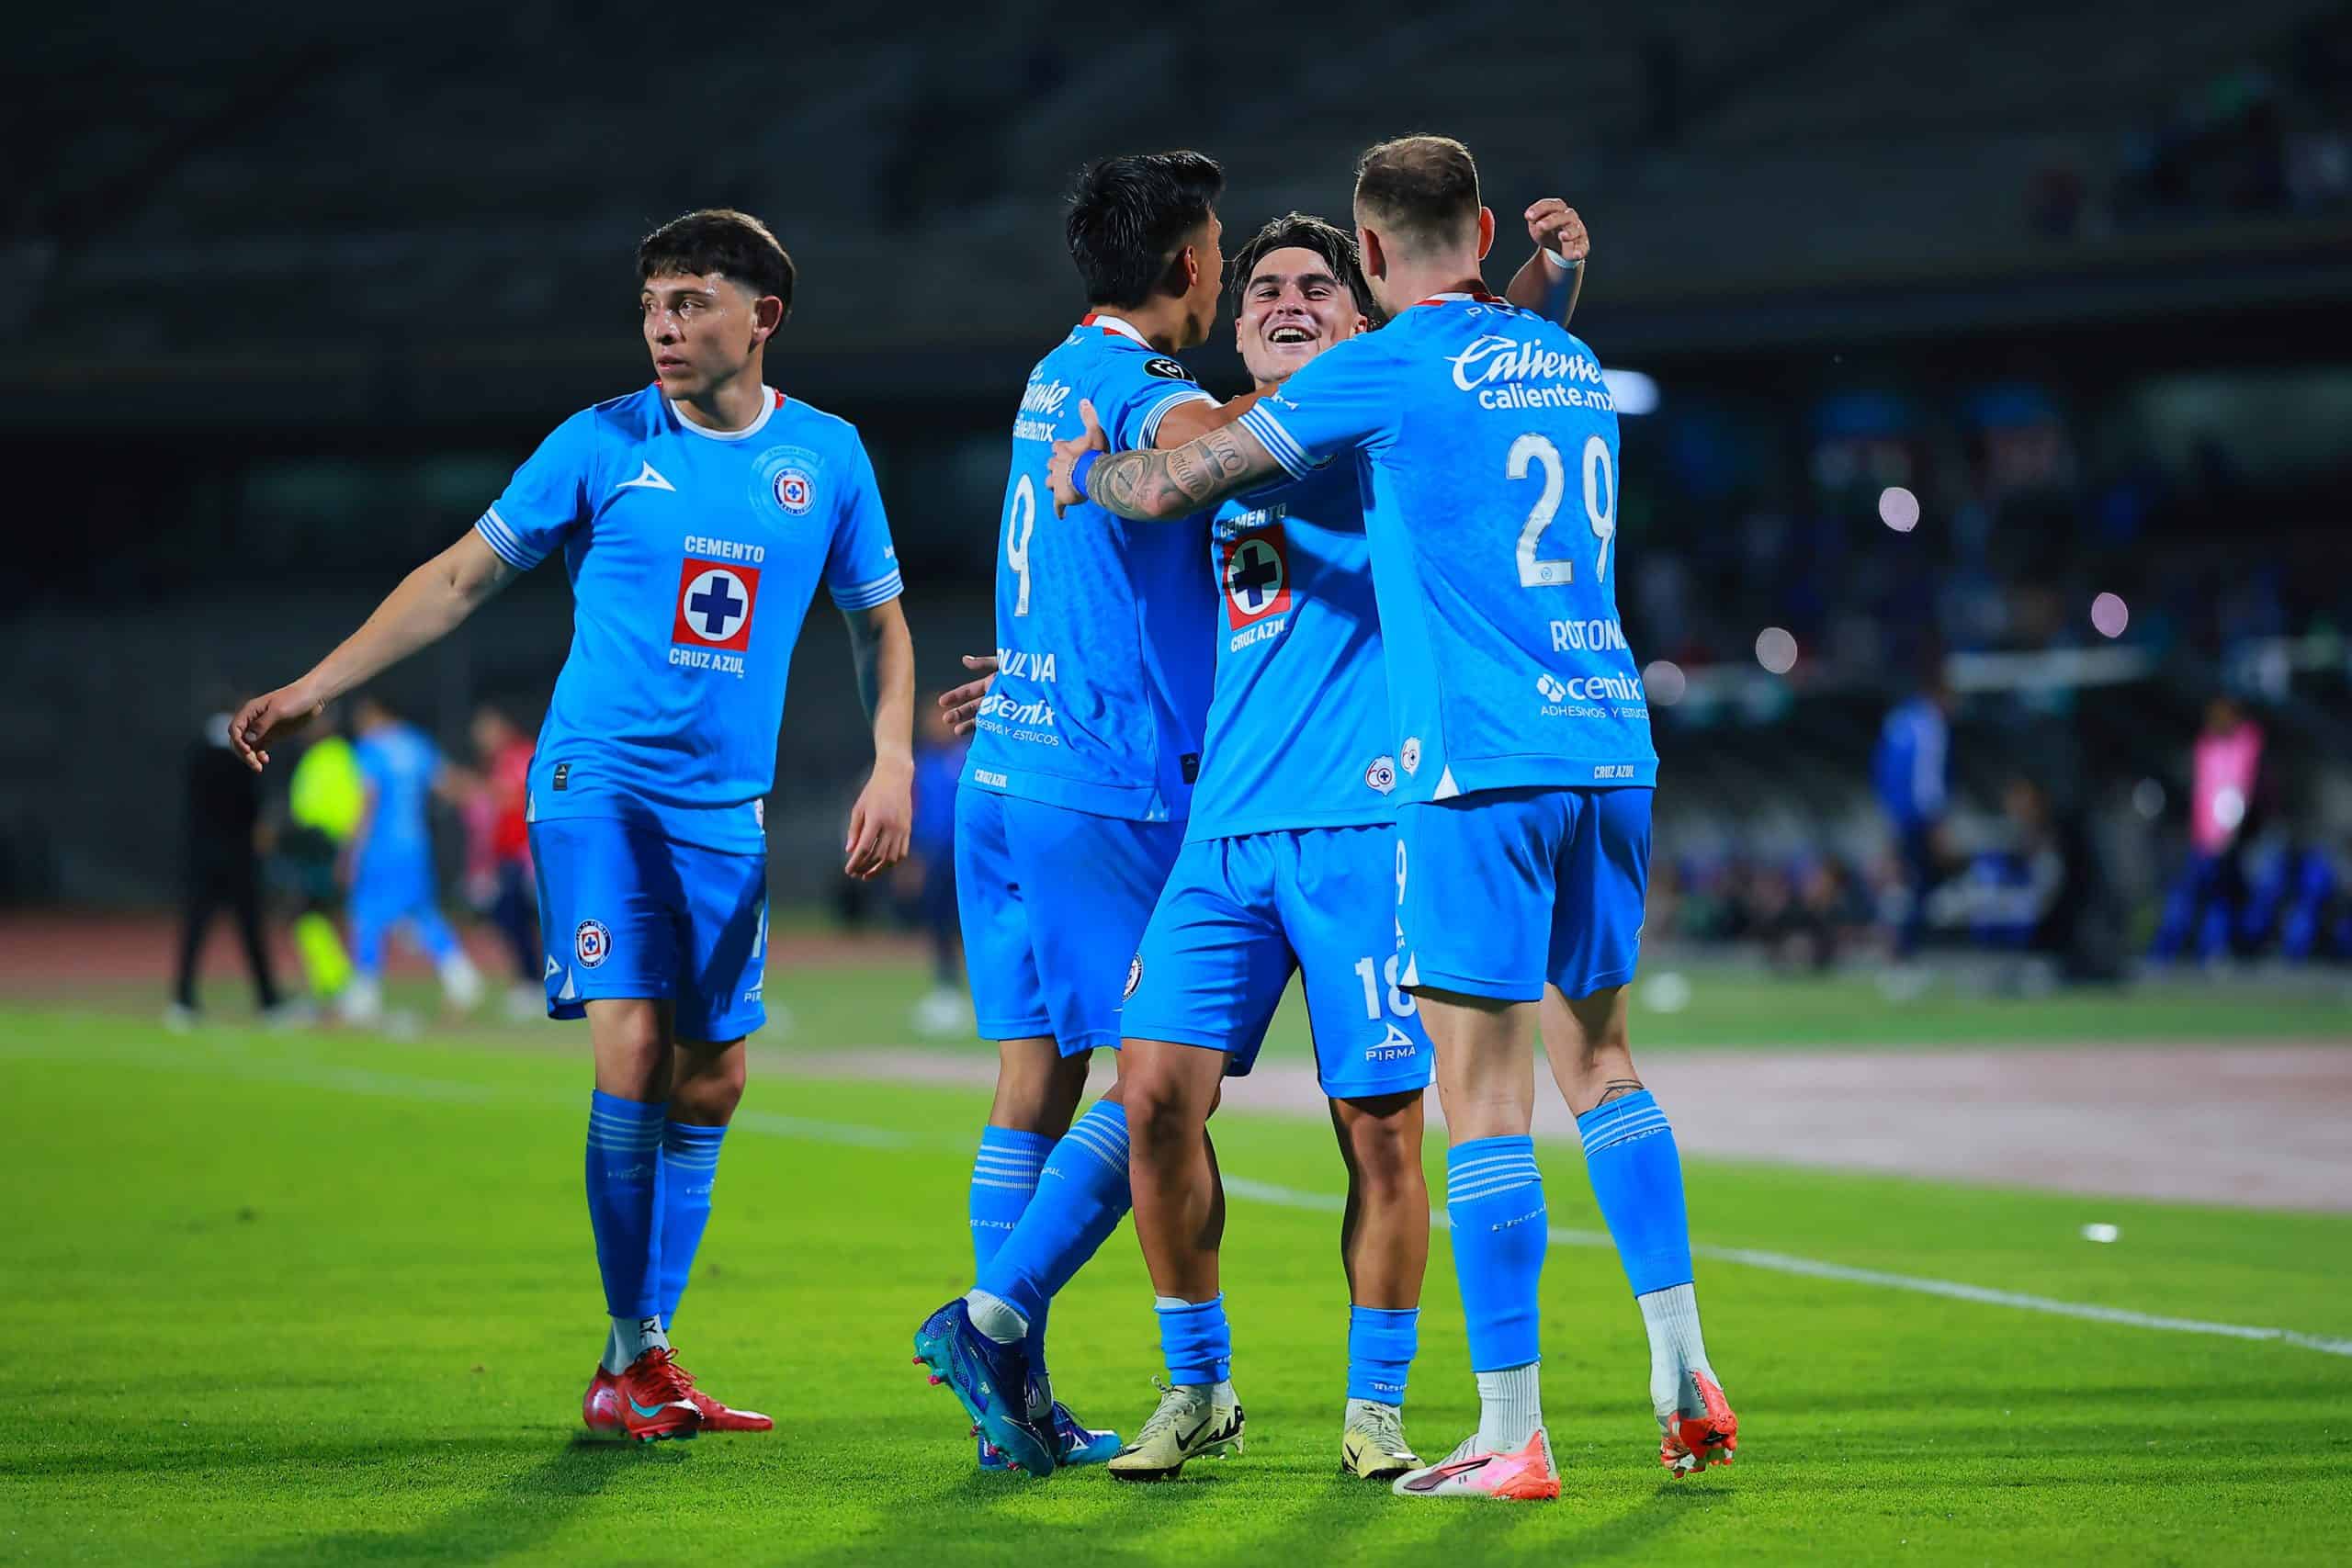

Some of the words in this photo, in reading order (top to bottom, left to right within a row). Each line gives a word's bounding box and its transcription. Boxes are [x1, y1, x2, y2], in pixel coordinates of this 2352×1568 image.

[1442, 334, 1602, 391] Caliente
[1219, 502, 1287, 538] CEMENTO
[1506, 433, 1615, 588] 29
[684, 535, 765, 563] CEMENTO
[1007, 474, 1035, 616] 9
[1229, 628, 1258, 652] CRUZ
[668, 647, 710, 670] CRUZ
[711, 653, 745, 674] AZUL
[1566, 671, 1642, 702] cemix
[1610, 706, 1620, 718] Y
[1594, 766, 1614, 779] CRUZ
[1616, 764, 1634, 779] AZUL
[1354, 953, 1417, 1020] 18
[1365, 1045, 1417, 1062] PIRMA
